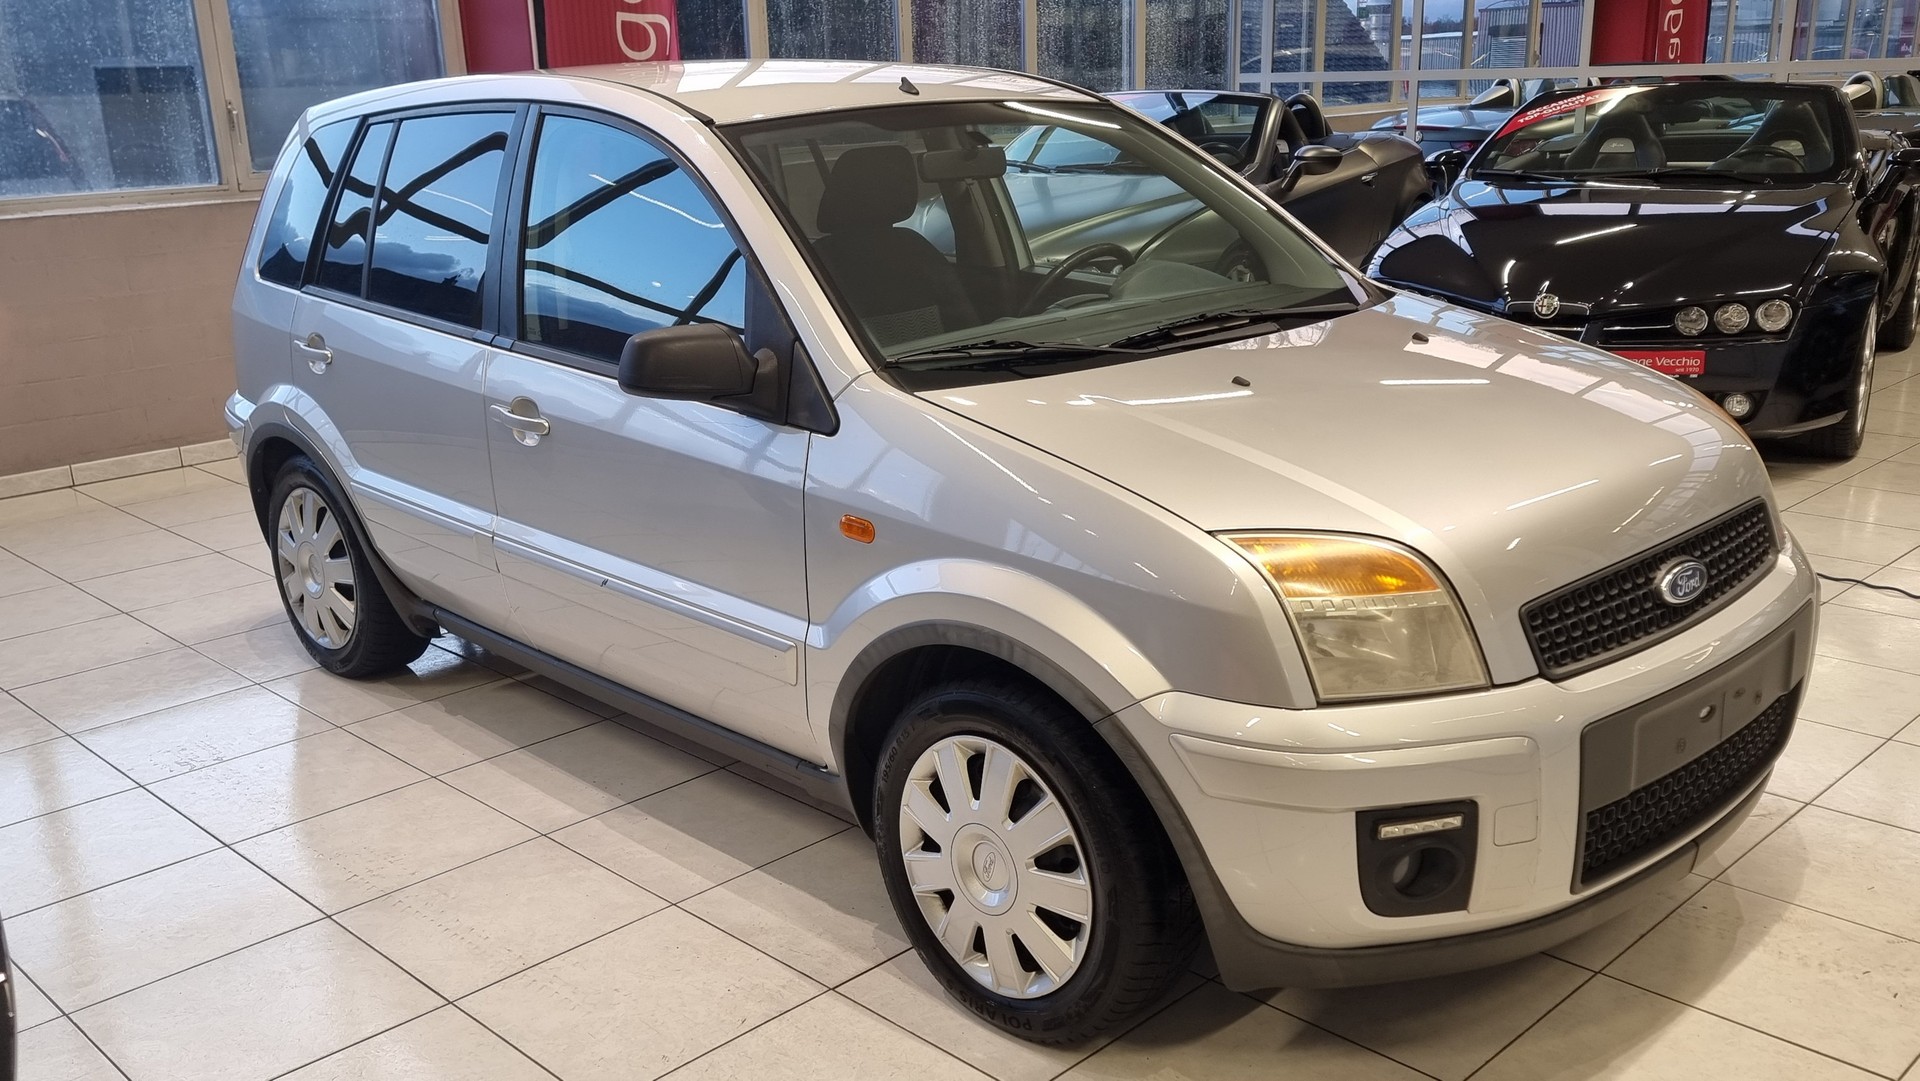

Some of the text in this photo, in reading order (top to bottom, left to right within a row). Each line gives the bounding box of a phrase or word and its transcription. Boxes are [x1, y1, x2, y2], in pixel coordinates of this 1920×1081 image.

[1526, 94, 1586, 115] OCCASION
[1655, 356, 1701, 366] Vecchio
[1677, 569, 1701, 597] Ford
[881, 746, 898, 783] 195/60
[958, 989, 1033, 1031] POLARIS
